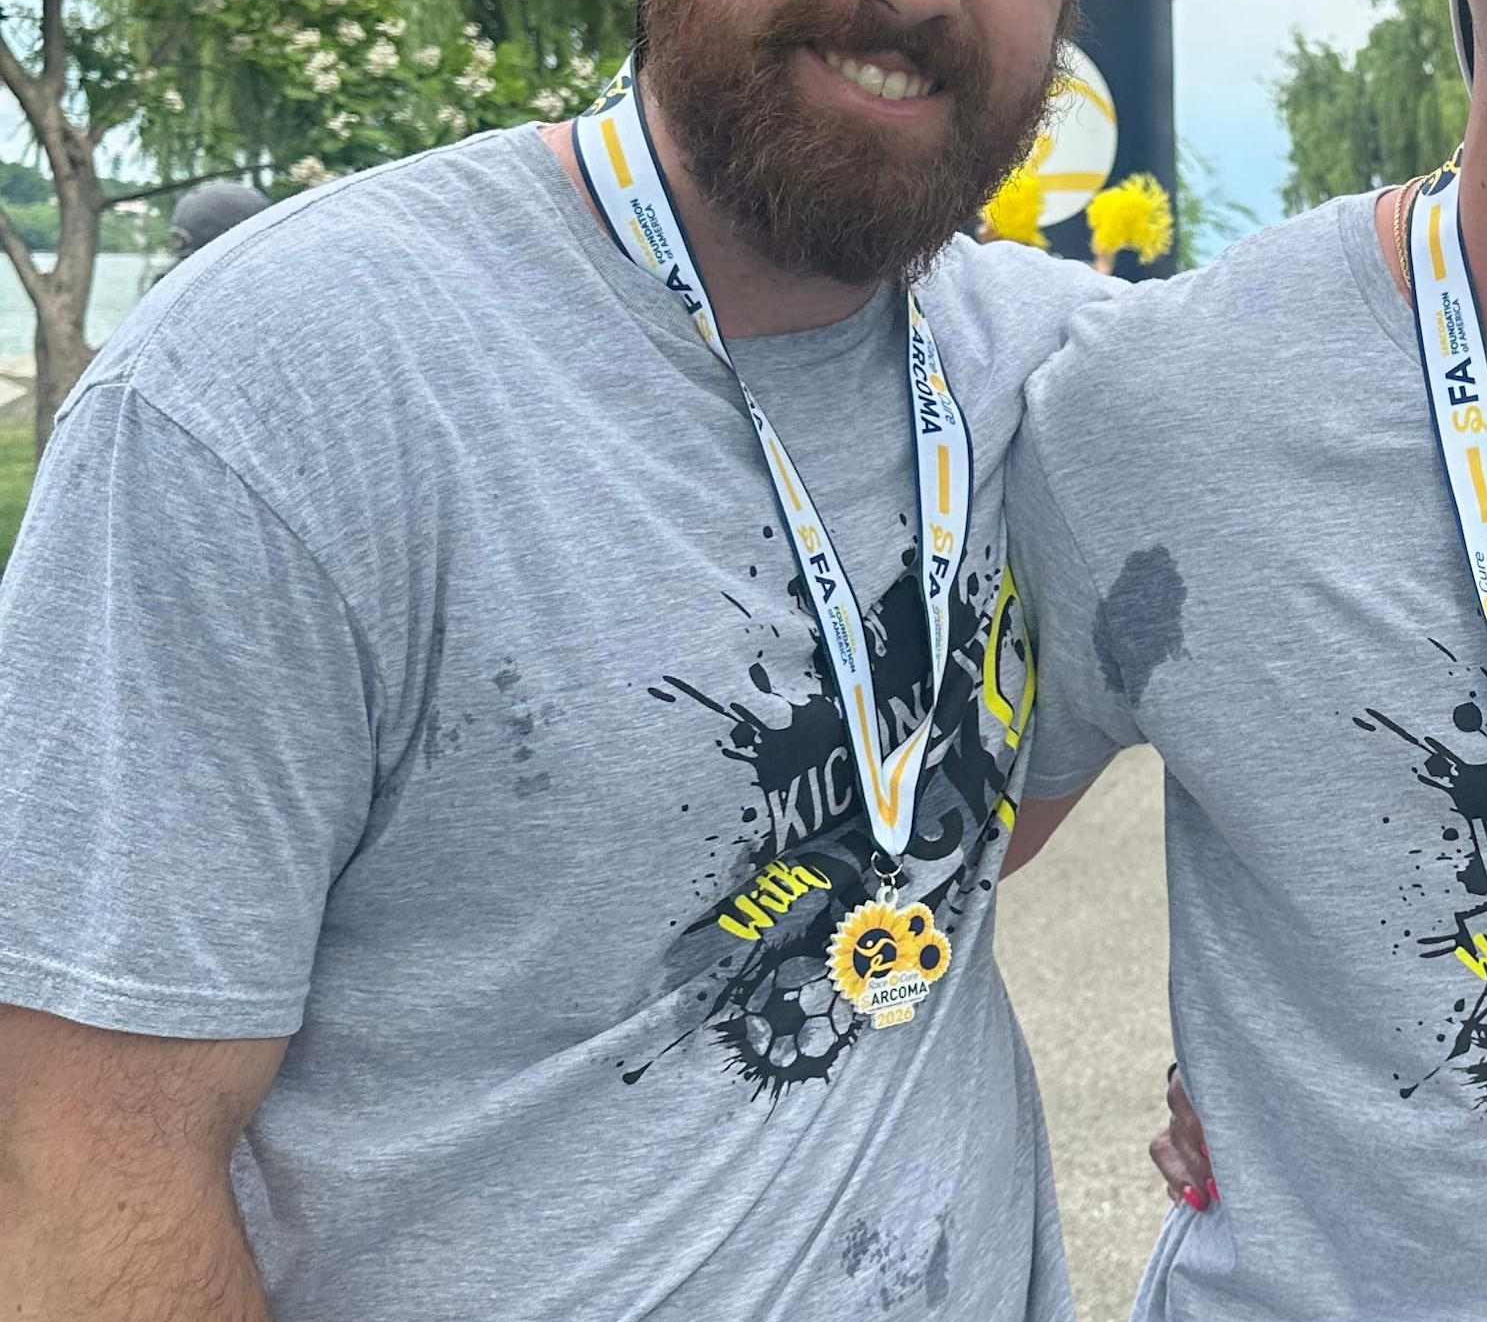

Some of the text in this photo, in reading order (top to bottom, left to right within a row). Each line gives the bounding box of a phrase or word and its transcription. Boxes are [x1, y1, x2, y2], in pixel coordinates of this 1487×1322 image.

[631, 198, 666, 264] FOUNDATION
[1441, 291, 1459, 355] FOUNDATION
[797, 525, 837, 604] SFA
[929, 523, 954, 599] SFA
[834, 605, 856, 674] FOUNDATION
[719, 860, 832, 941] With
